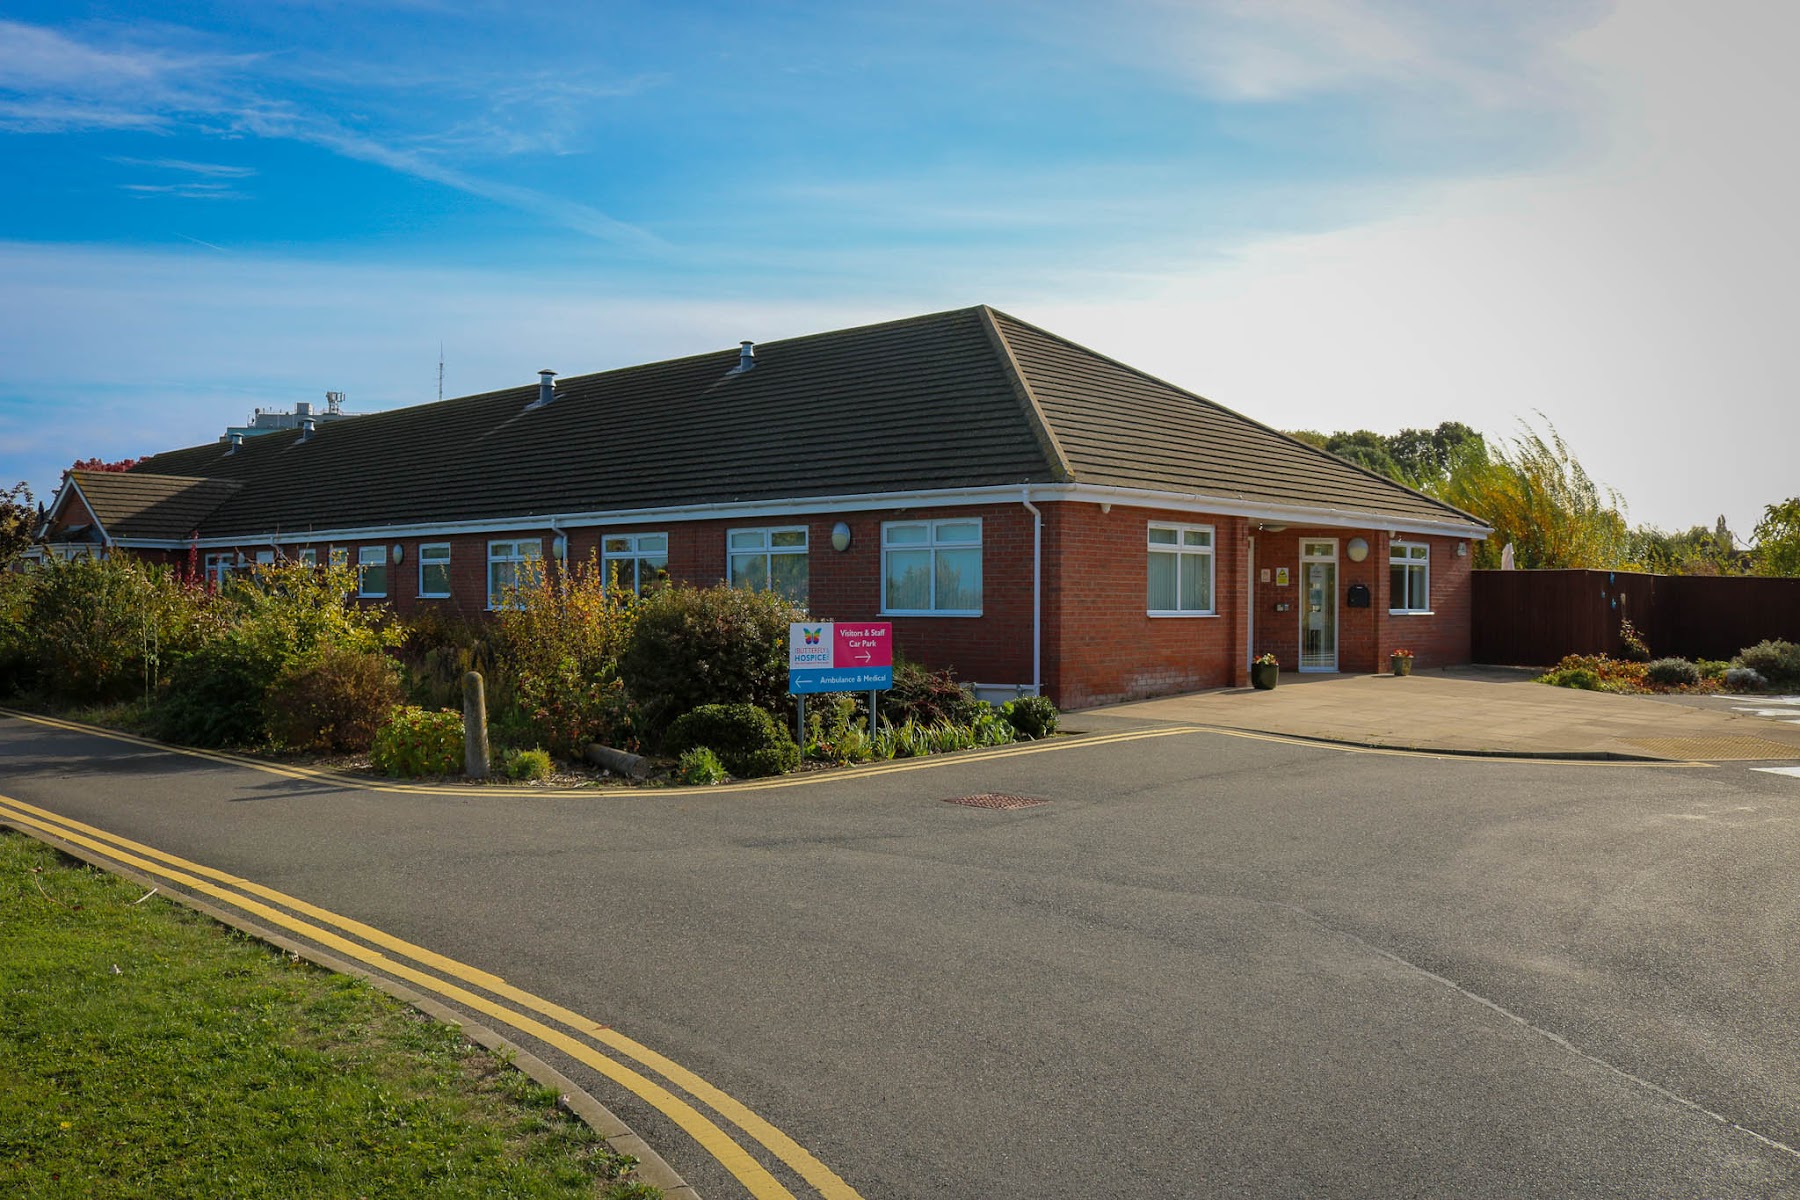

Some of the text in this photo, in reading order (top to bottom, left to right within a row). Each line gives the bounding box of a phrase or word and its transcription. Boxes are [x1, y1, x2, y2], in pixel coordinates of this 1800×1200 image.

[840, 629, 863, 637] Visitors
[871, 629, 885, 637] Staff
[820, 676, 855, 684] Ambulance
